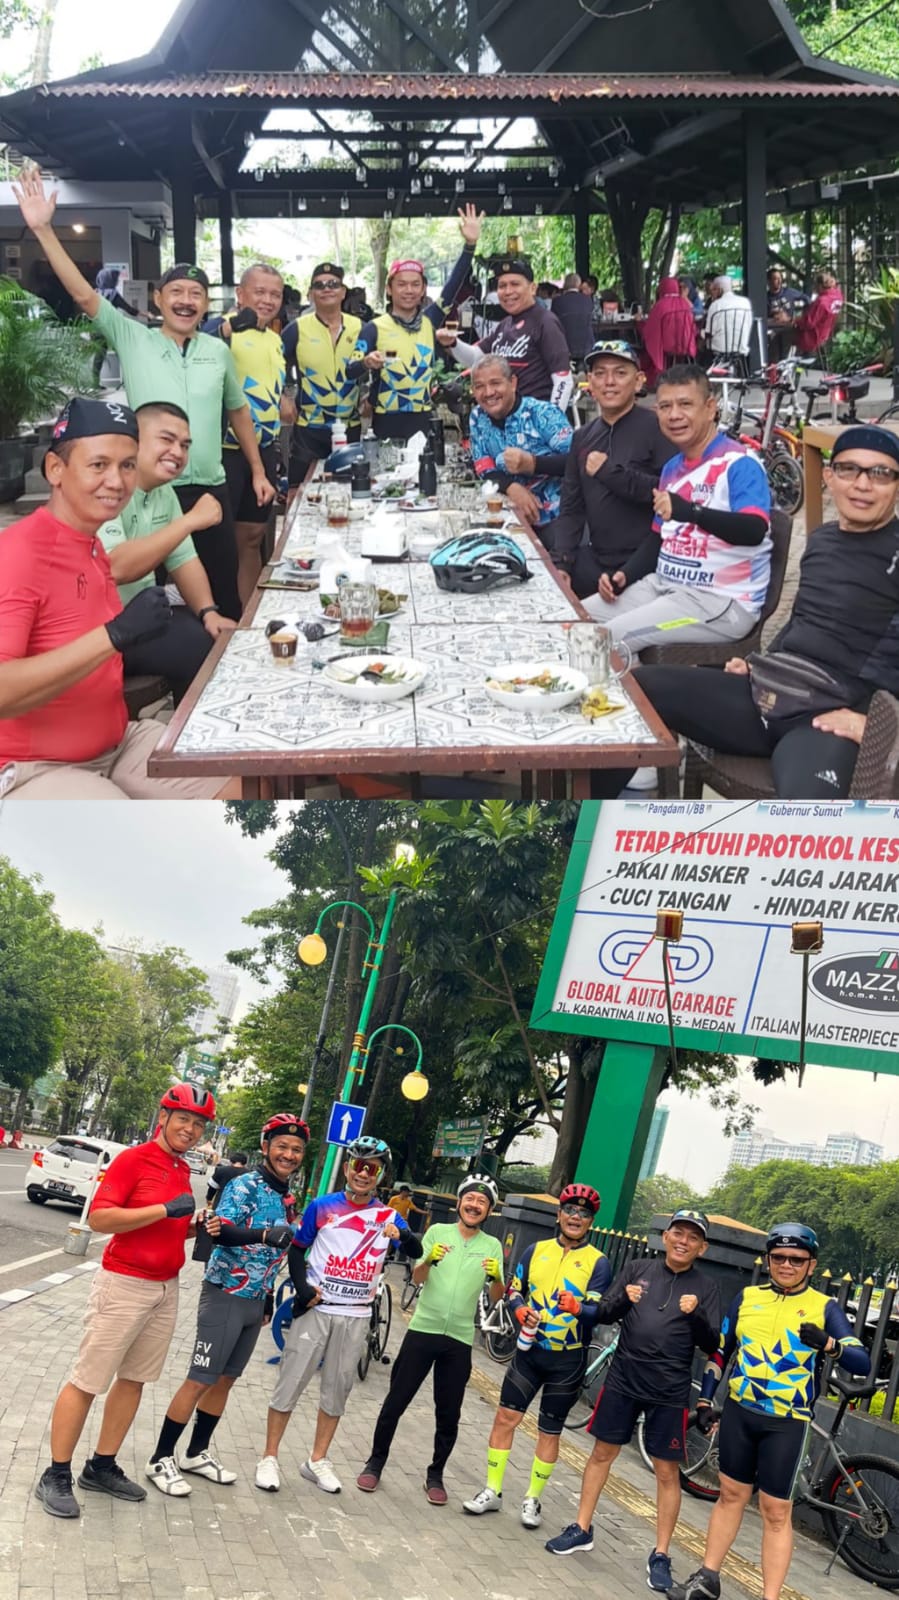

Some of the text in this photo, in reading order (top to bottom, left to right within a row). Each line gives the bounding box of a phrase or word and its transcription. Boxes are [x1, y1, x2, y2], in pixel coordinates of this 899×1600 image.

[663, 564, 714, 582] BAHURI
[648, 803, 685, 816] Pangdam
[770, 805, 843, 817] Gubernur Sumut
[615, 830, 899, 863] TETAP PATUHI PROTOKOL KES
[615, 861, 669, 880] PAKAI
[671, 864, 749, 885] MASKER
[771, 868, 824, 888] JAGA
[829, 871, 899, 892] JARAK
[610, 887, 653, 906] CUCI
[657, 890, 731, 911] TANGAN
[764, 896, 850, 919] HINDARI
[852, 901, 899, 923] KER
[826, 969, 899, 993] MAZZ
[567, 980, 737, 1017] GLOBAL AUTO GARAGE
[556, 1001, 570, 1013] JL.
[573, 1004, 634, 1021] KARANTINA
[637, 1010, 645, 1022] II
[647, 1012, 665, 1025] NO.
[692, 1017, 736, 1032] MEDAN
[751, 1015, 899, 1048] ITALIAN MASTERPIECE
[324, 1266, 373, 1282] INDONESIA
[326, 1254, 377, 1274] SMASH
[196, 1340, 212, 1353] FV
[193, 1353, 210, 1368] SM
